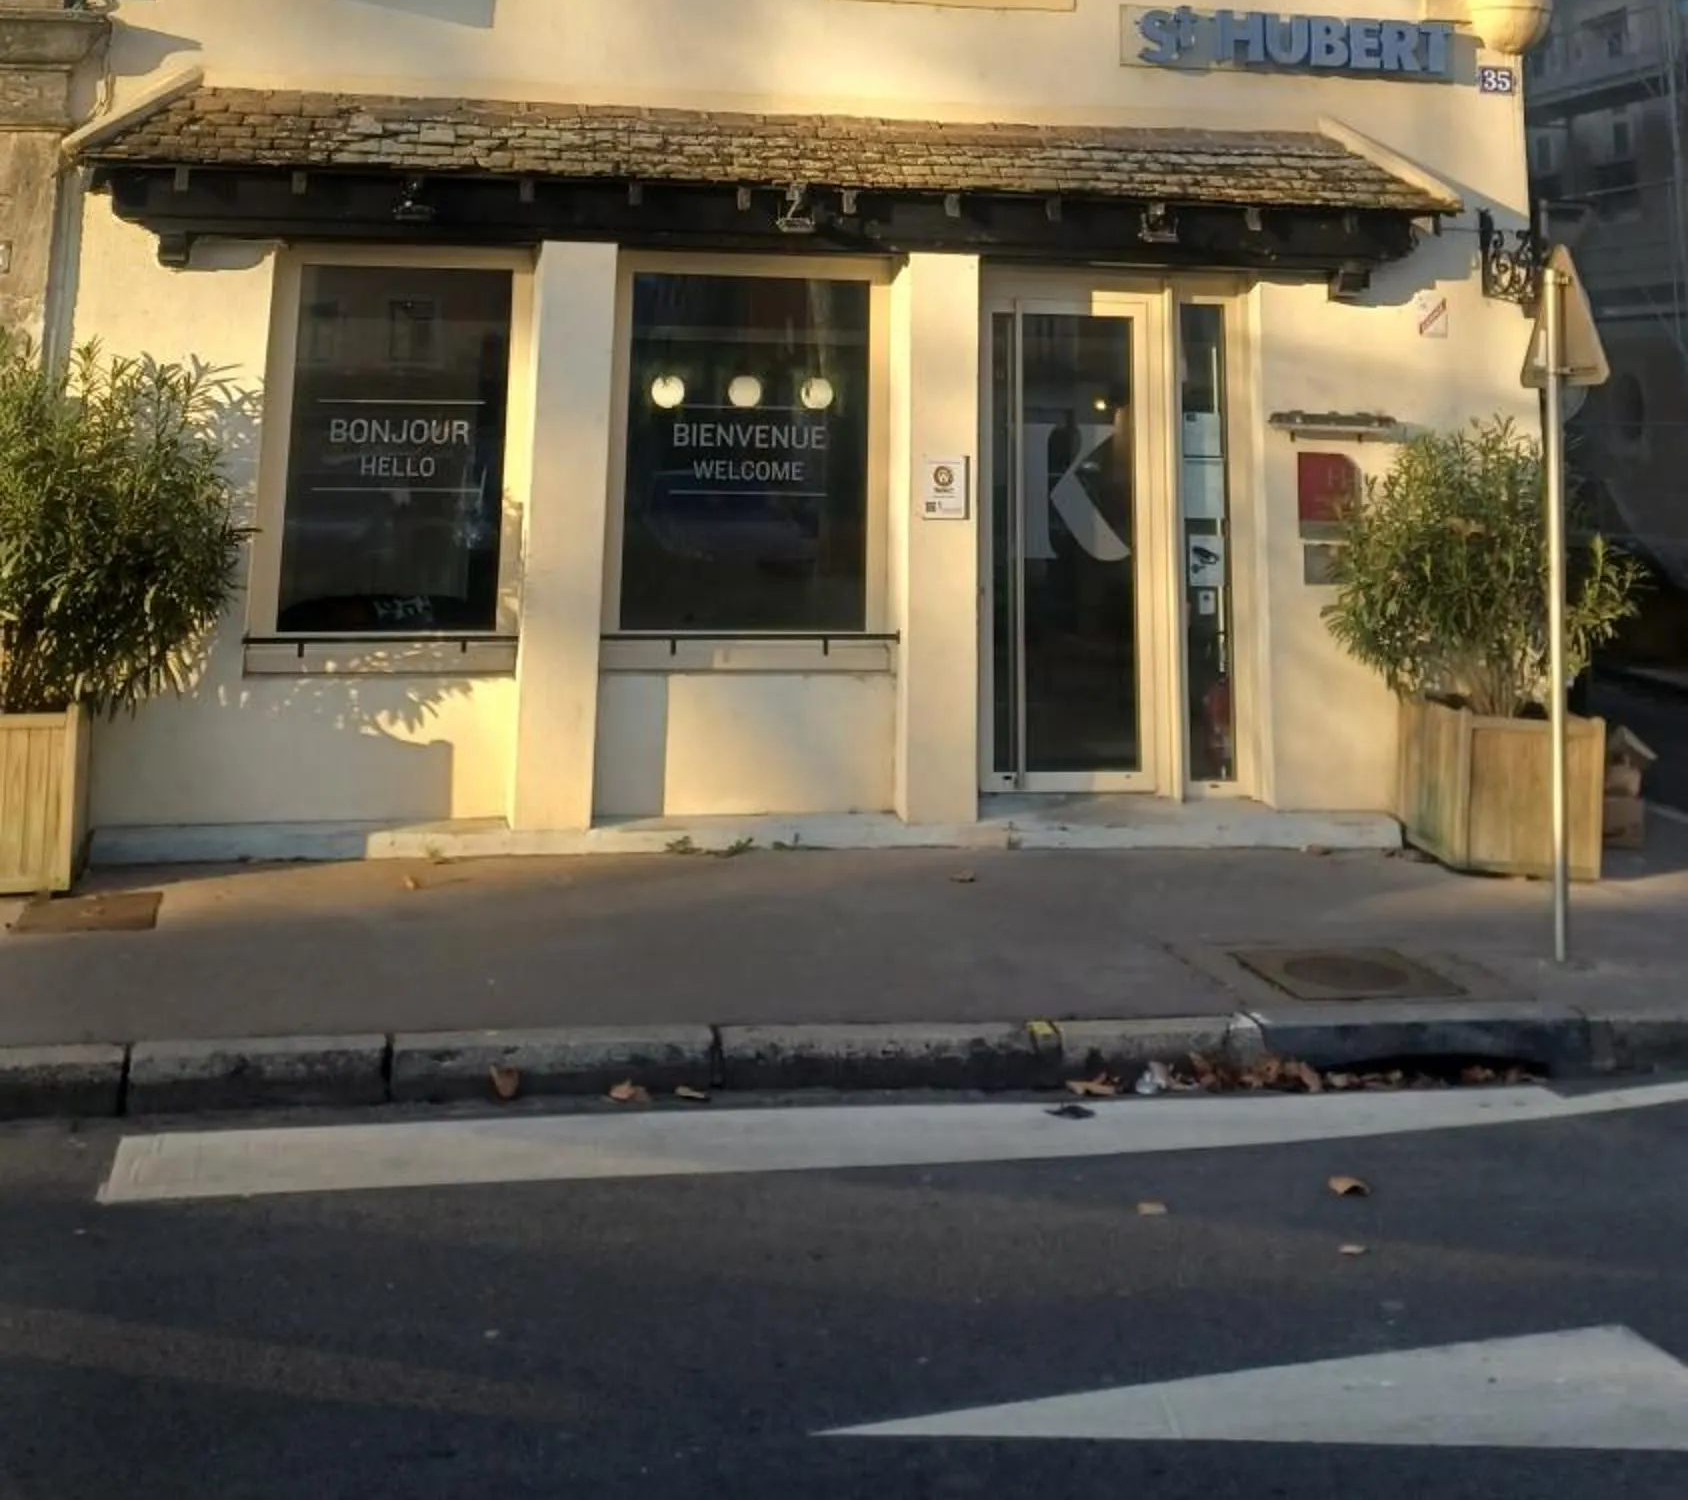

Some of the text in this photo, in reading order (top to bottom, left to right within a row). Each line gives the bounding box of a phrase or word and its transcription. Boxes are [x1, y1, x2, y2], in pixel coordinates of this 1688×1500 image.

[1213, 9, 1454, 73] HUBERT
[1483, 70, 1512, 92] 35
[329, 418, 470, 445] BONJOUR
[672, 423, 827, 449] BIENVENUE
[360, 456, 436, 477] HELLO
[693, 459, 805, 481] WELCOME
[1022, 423, 1132, 562] K
